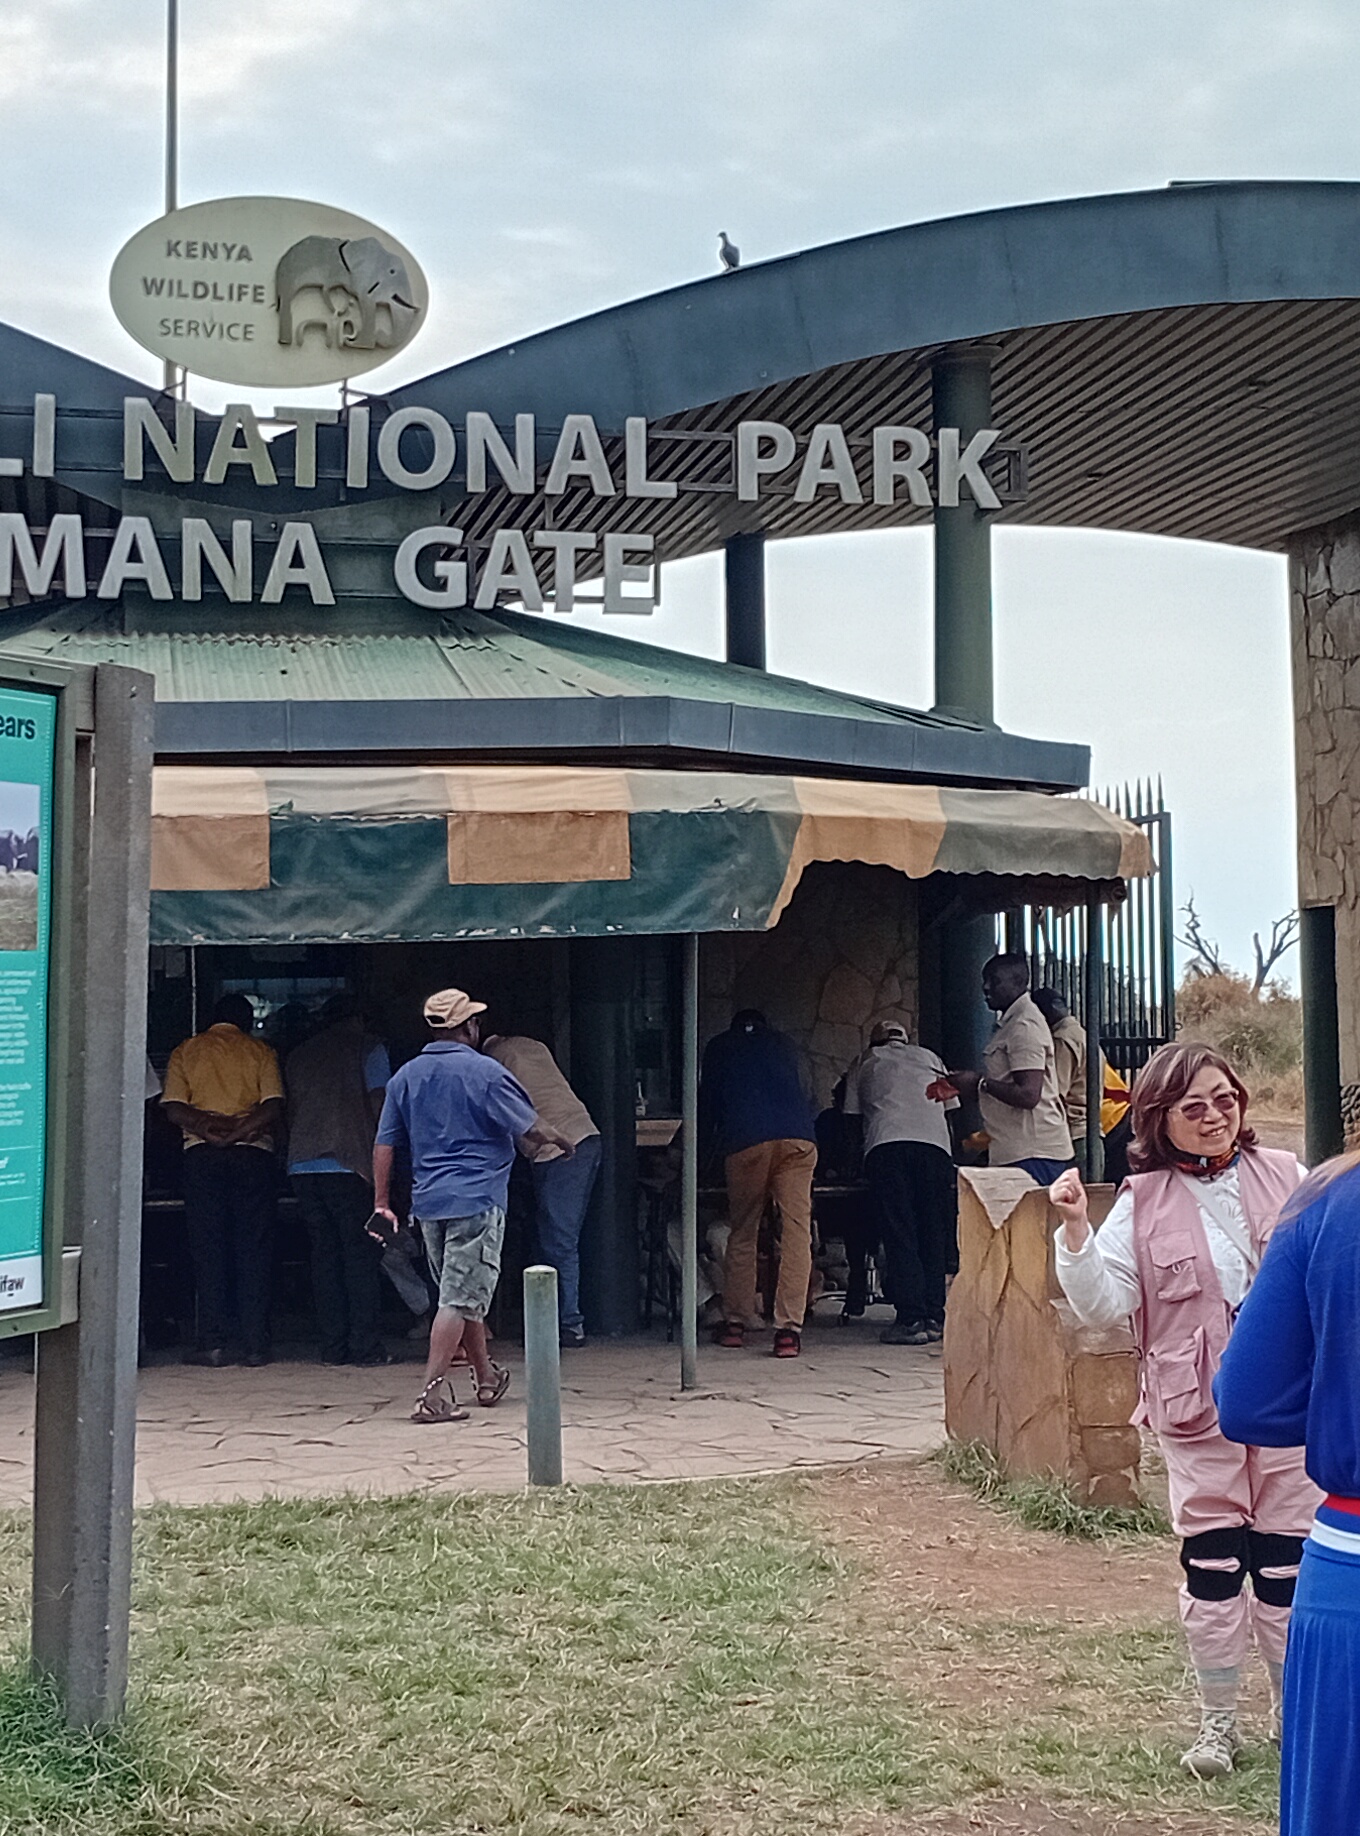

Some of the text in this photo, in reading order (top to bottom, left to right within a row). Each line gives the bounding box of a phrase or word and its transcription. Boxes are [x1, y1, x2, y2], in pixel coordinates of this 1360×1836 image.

[165, 239, 253, 262] KENYA
[142, 276, 266, 304] WILDLIFE
[159, 318, 255, 342] SERVICE
[123, 396, 678, 499] NATIONAL
[738, 420, 1005, 509] PARK
[393, 525, 656, 615] GATE
